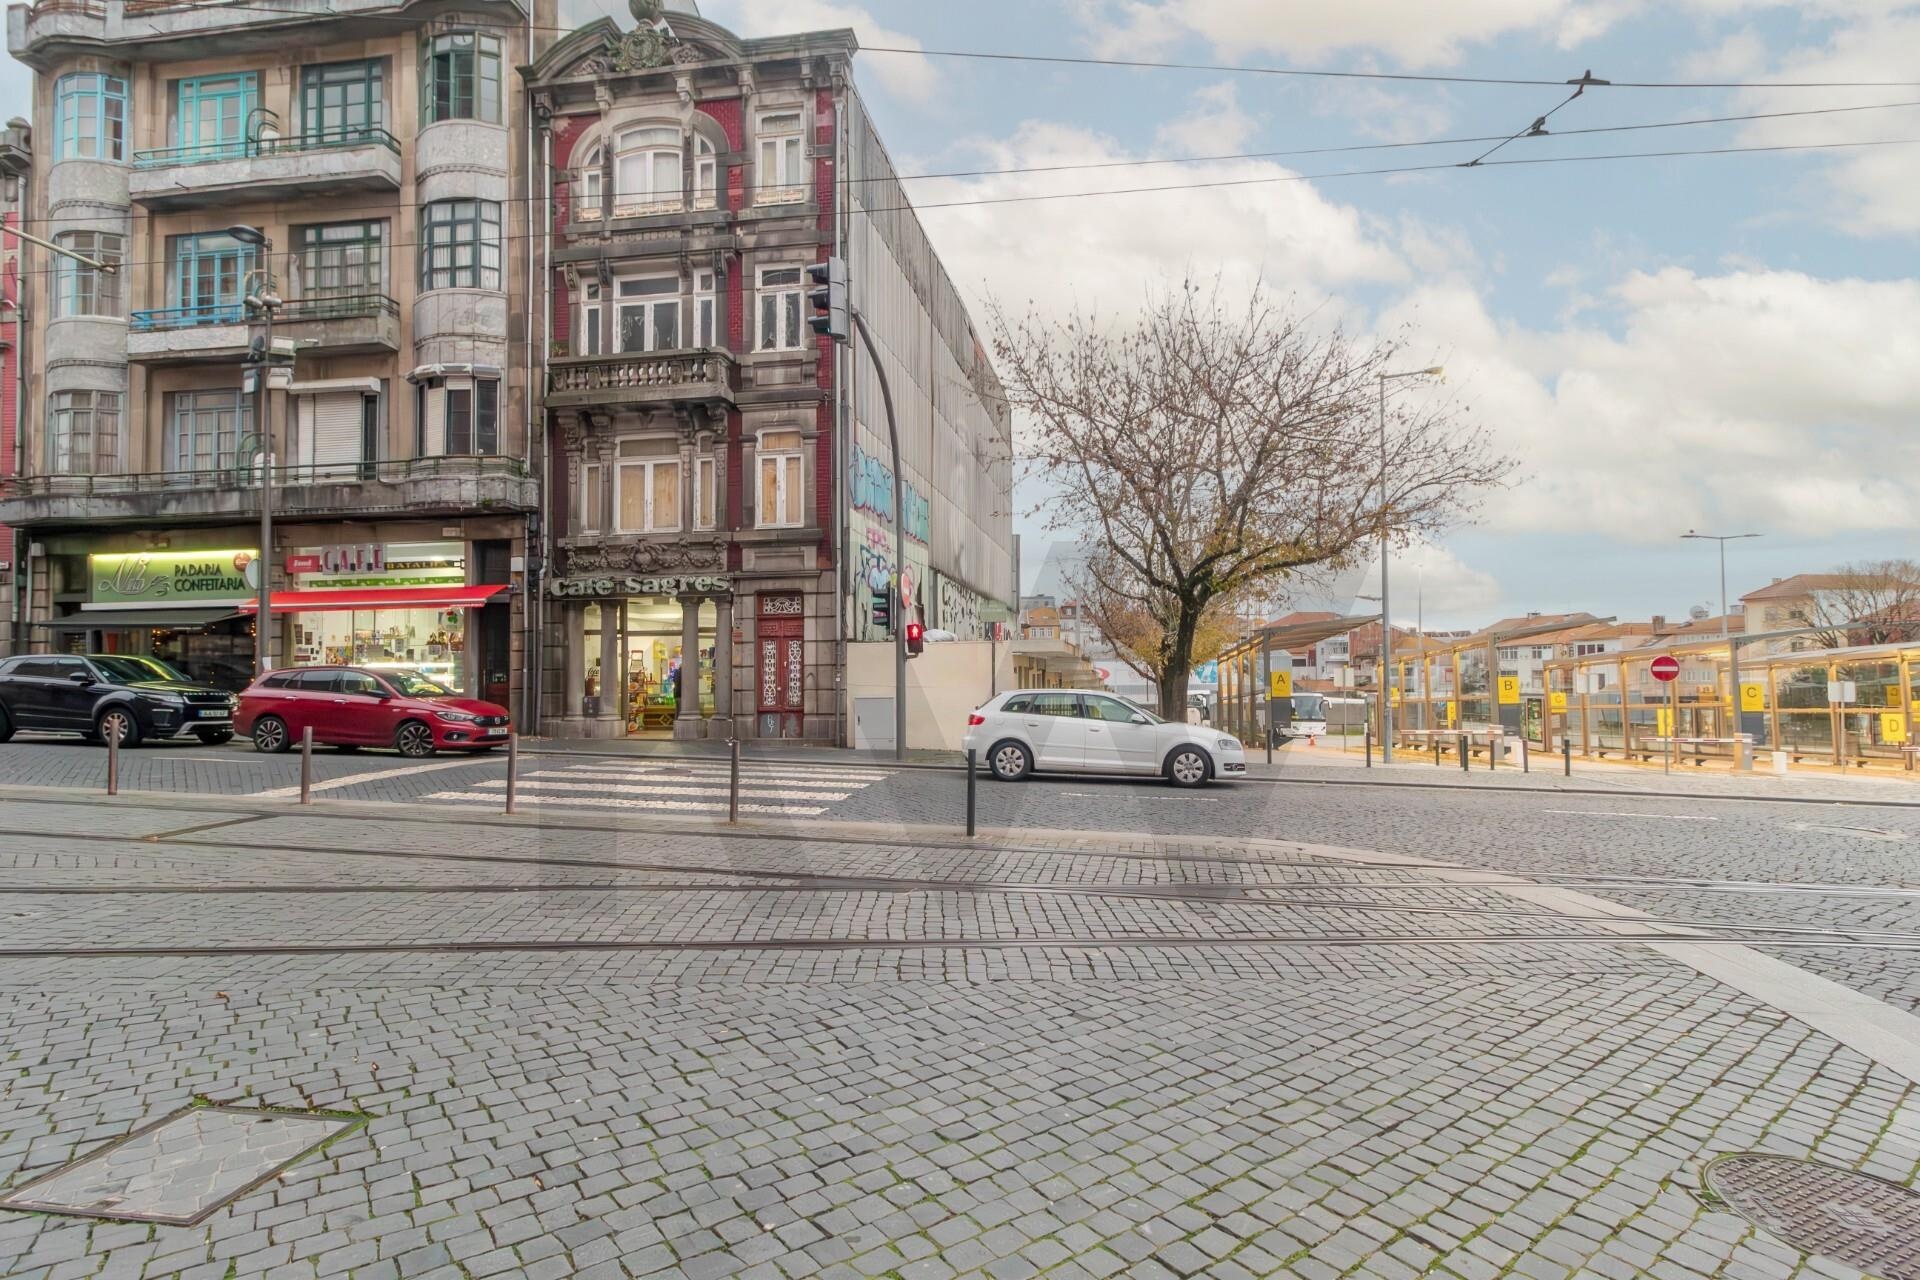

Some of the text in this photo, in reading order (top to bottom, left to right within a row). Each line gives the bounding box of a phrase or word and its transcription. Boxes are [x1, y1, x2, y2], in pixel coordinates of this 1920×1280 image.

[174, 564, 222, 577] PADARIA
[174, 577, 246, 592] CONFEITARIA
[1276, 674, 1286, 685] A
[1504, 680, 1513, 691] B
[1746, 687, 1757, 698] C
[1889, 719, 1899, 732] D
